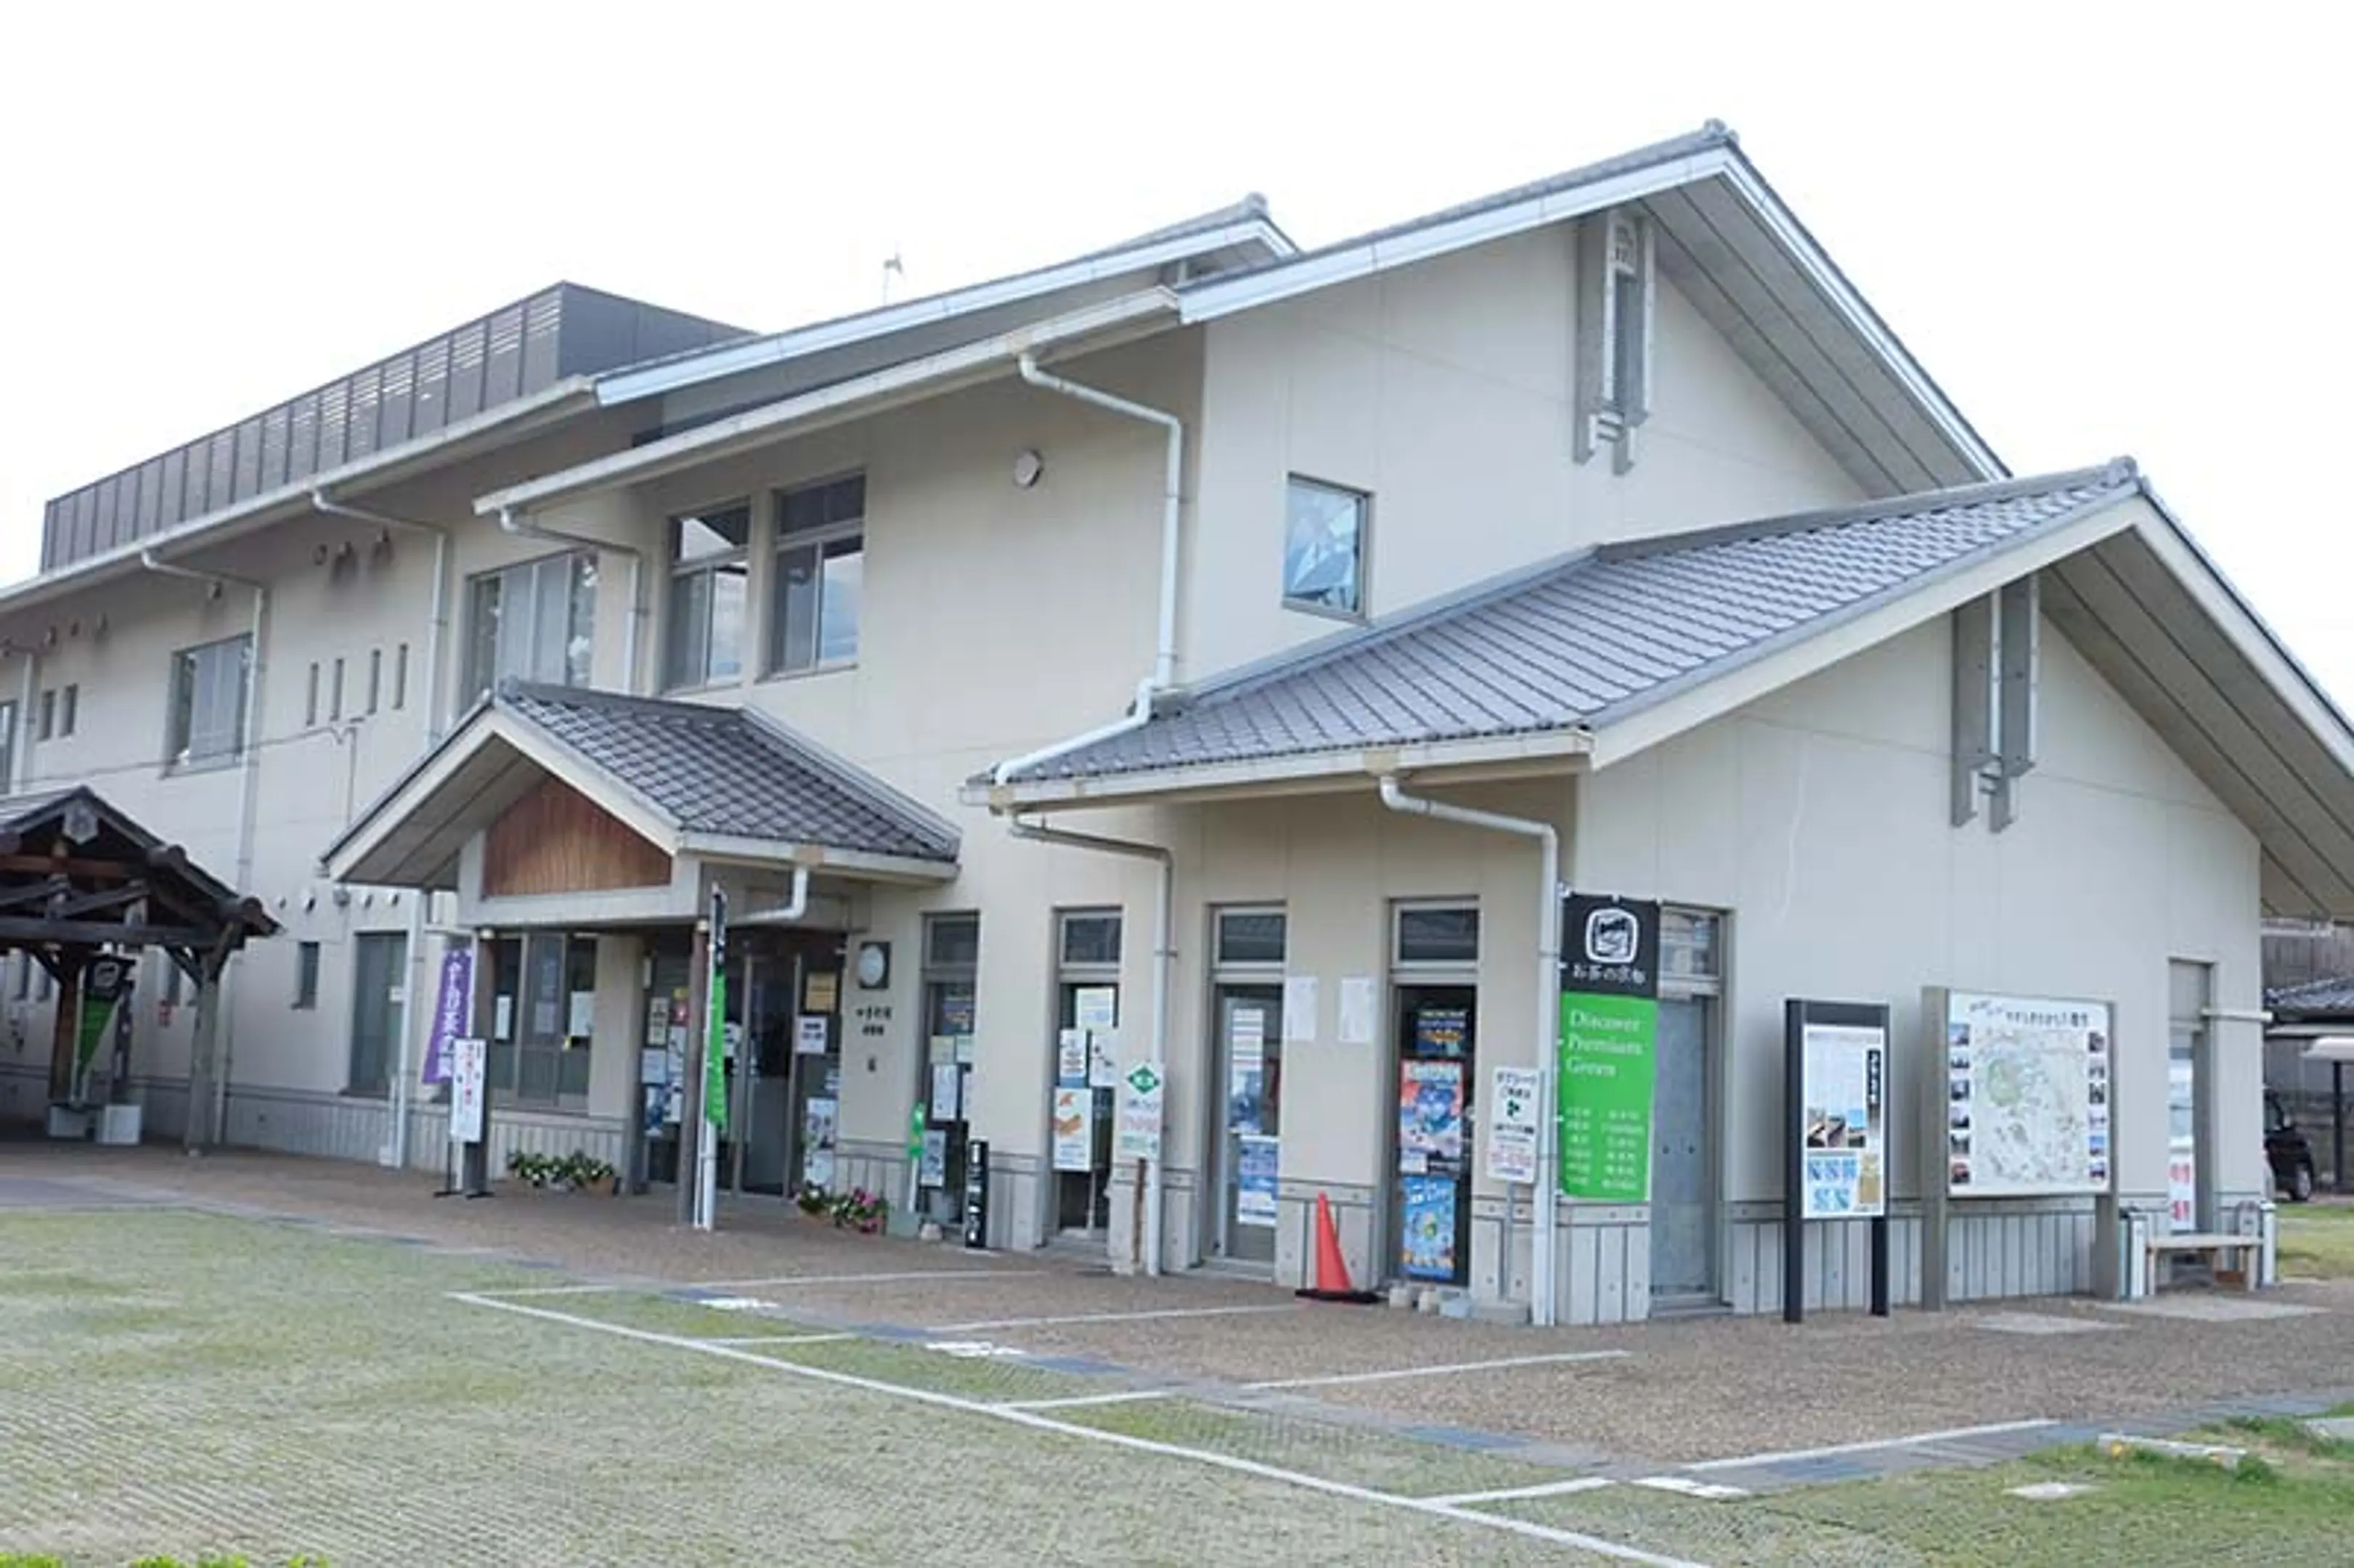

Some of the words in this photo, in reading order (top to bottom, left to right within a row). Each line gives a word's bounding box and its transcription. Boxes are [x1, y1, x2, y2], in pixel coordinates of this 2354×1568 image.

[1570, 1009, 1642, 1032] Discover
[1568, 1033, 1644, 1055] Premium
[1565, 1055, 1616, 1077] Green
